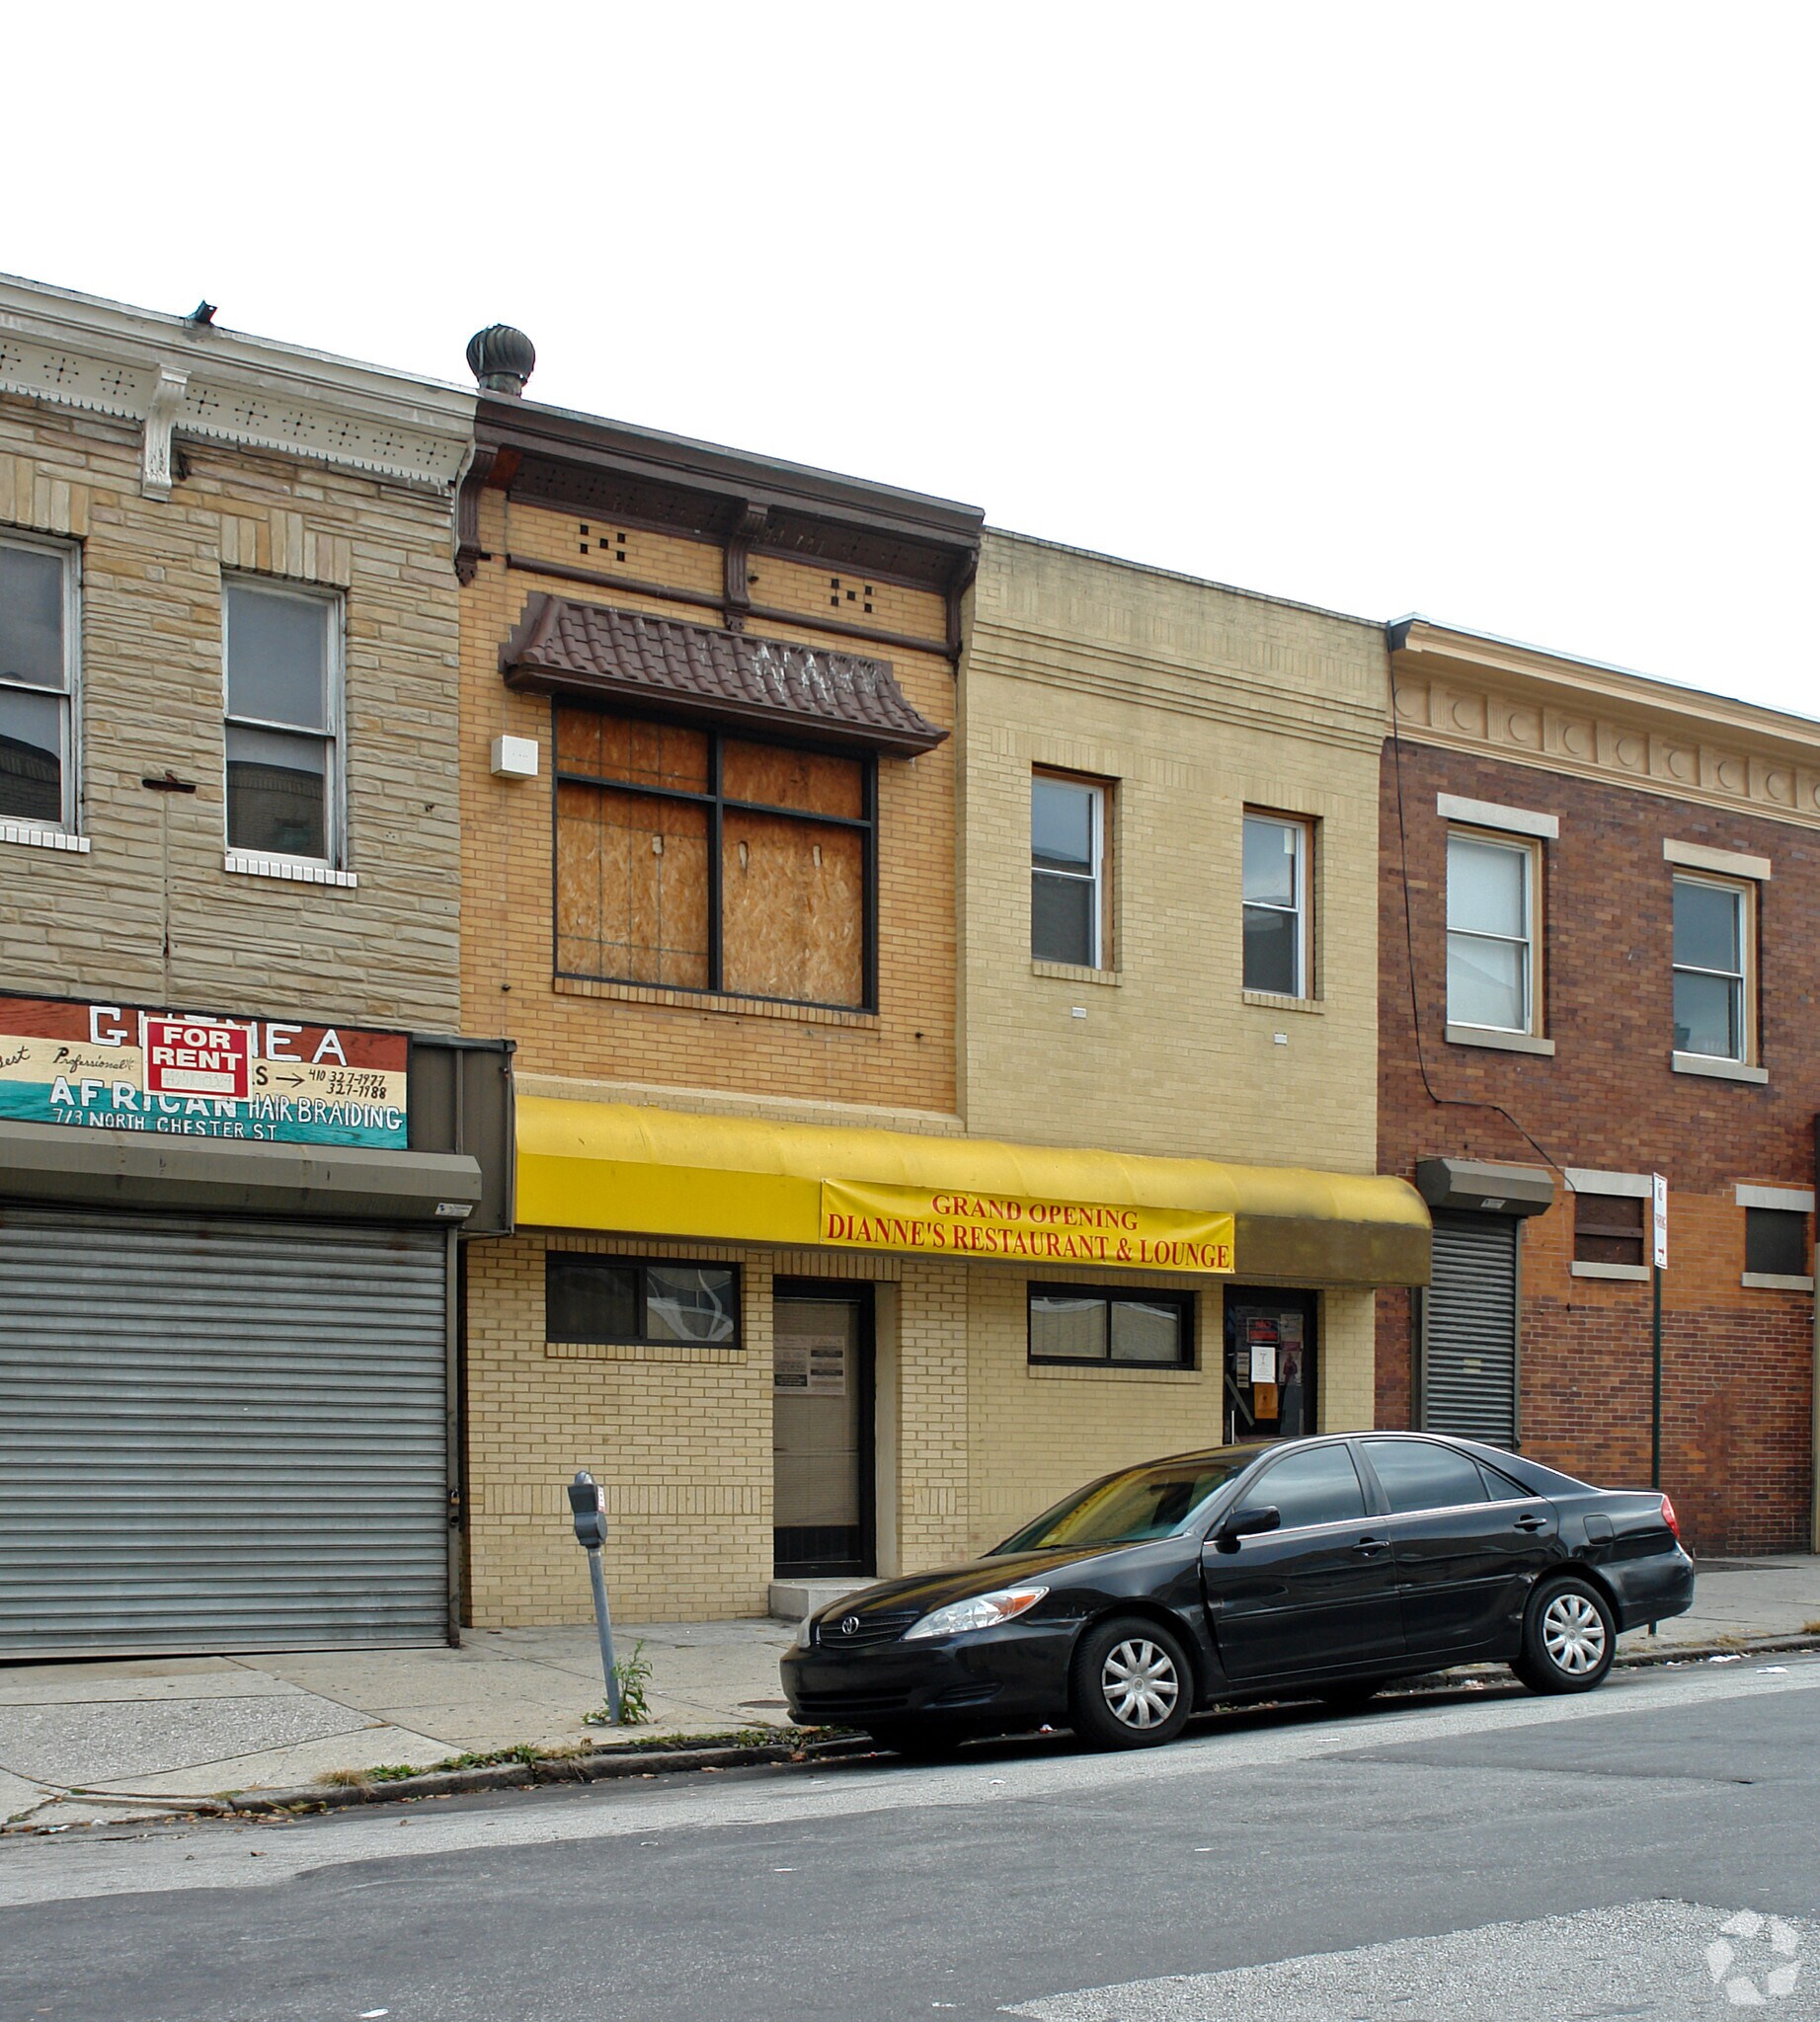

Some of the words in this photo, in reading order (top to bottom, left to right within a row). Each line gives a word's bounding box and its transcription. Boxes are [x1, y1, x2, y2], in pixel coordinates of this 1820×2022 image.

[89, 1005, 348, 1066] GEA
[163, 1026, 231, 1050] FOR
[152, 1046, 243, 1071] RENT
[308, 1068, 326, 1082] 410
[328, 1070, 386, 1087] 327-1977
[326, 1082, 387, 1099] 327-1988
[49, 1075, 237, 1118] AFRICAN
[249, 1093, 294, 1123] HAIR
[297, 1097, 403, 1130] BRAIDING
[89, 1111, 145, 1130] NORTH
[156, 1116, 244, 1138] CHESTER
[253, 1124, 277, 1140] ST
[931, 1194, 1022, 1220] GRAND
[1028, 1203, 1139, 1231] OPENING
[828, 1213, 945, 1248] DIANNE'S
[952, 1223, 1110, 1261] RESTAURANT
[1115, 1236, 1133, 1263] &
[1140, 1238, 1230, 1269] LOUNGE
